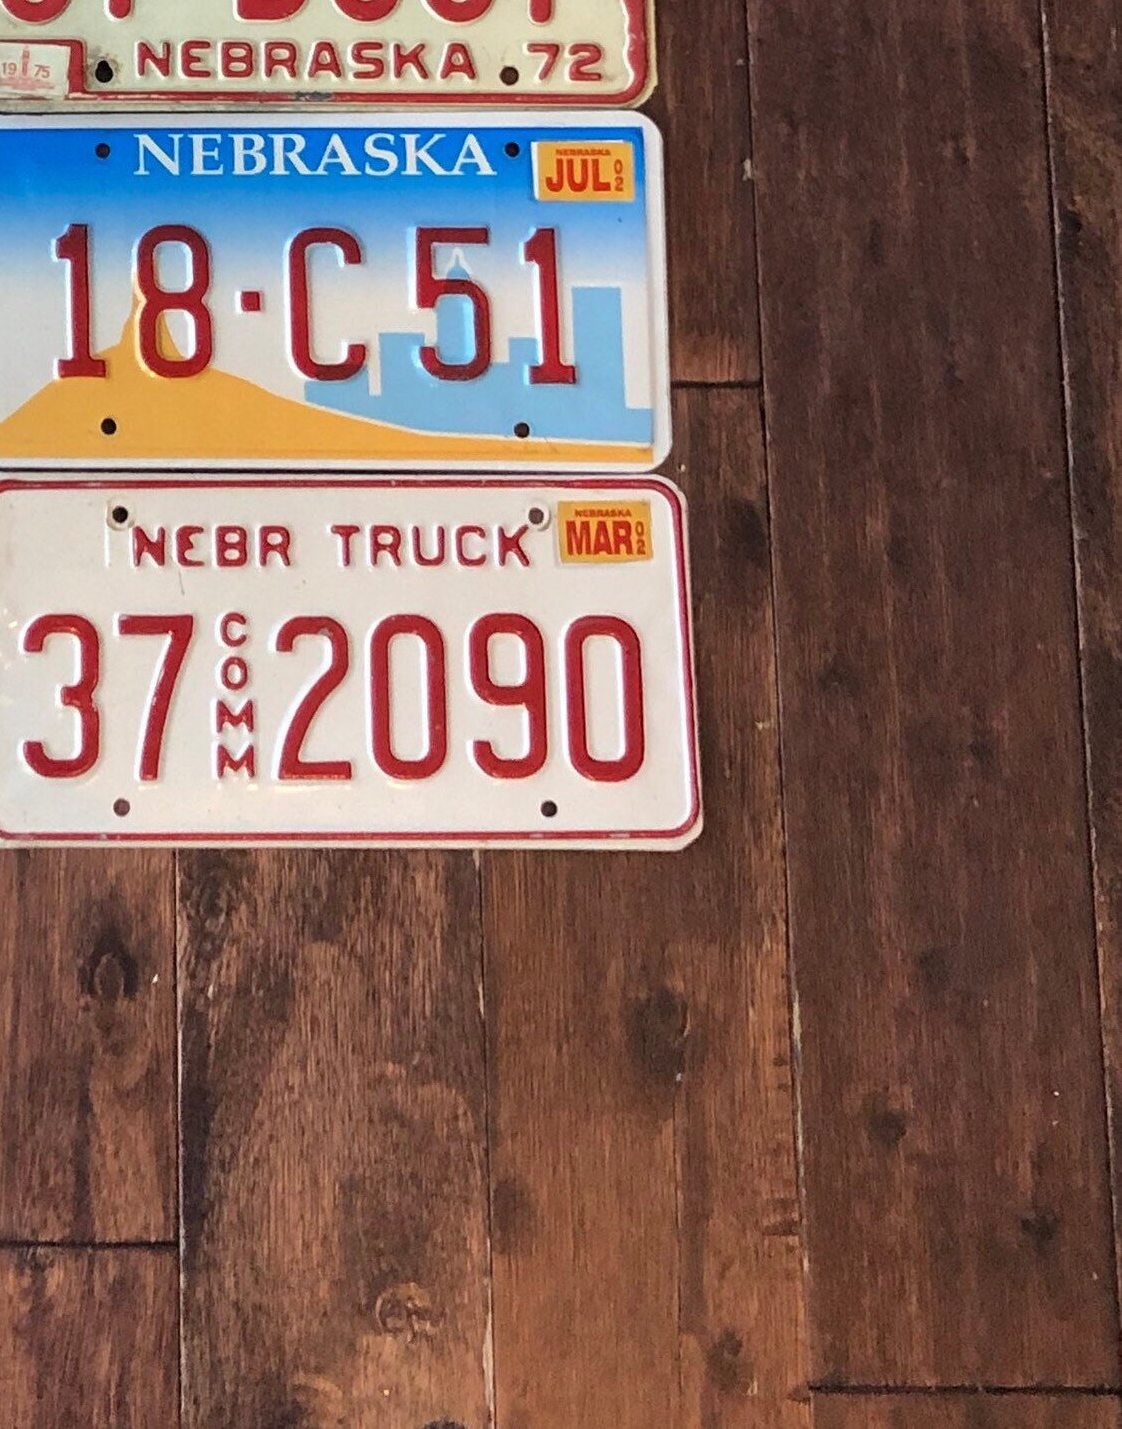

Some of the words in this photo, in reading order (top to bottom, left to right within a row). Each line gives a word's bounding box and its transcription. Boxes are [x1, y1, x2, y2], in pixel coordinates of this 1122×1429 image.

[136, 41, 478, 79] NEBRASKA
[525, 42, 603, 81] 72
[134, 134, 496, 176] NEBRASKA
[546, 159, 611, 192] JUL
[132, 525, 291, 567] NEBR
[330, 524, 530, 567] TRUCK
[566, 520, 633, 555] MAR
[22, 614, 194, 780] 37
[276, 613, 645, 782] 2090
